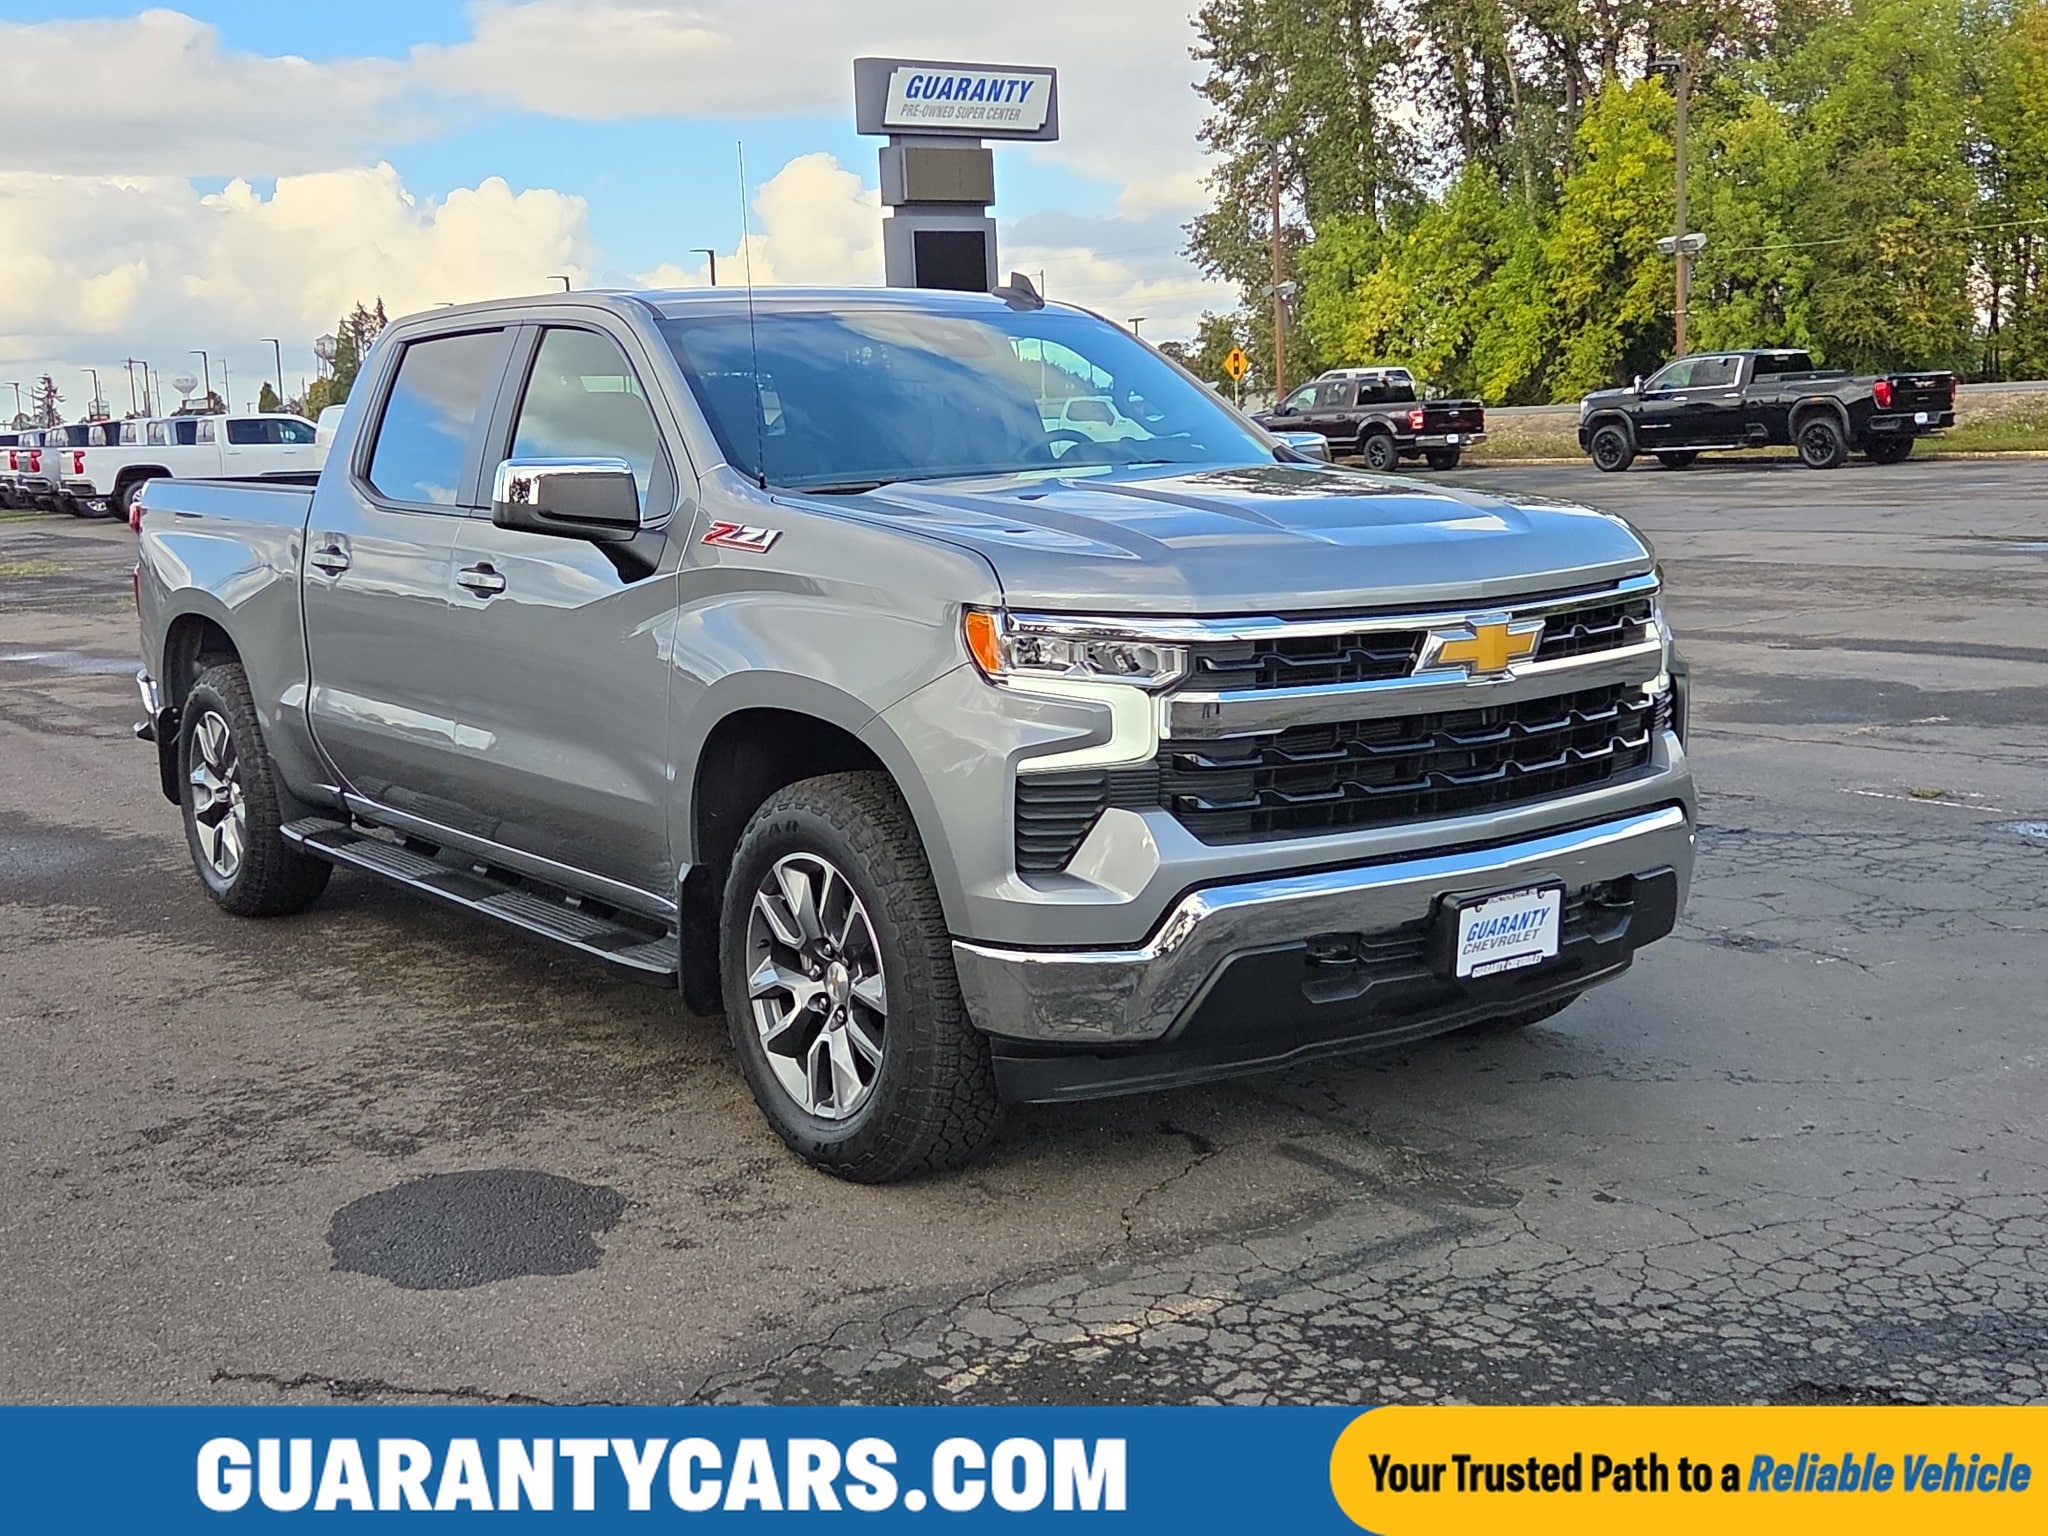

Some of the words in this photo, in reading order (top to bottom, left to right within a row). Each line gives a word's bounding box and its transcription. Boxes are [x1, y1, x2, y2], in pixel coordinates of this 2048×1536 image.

[905, 74, 1035, 103] GUARANTY
[900, 103, 954, 119] PRE-OWNED
[955, 106, 986, 120] SUPER
[986, 107, 1022, 121] CENTER
[700, 520, 783, 554] Z71
[1466, 907, 1550, 942] GUARANTY
[1462, 928, 1540, 955] CHEVROLET
